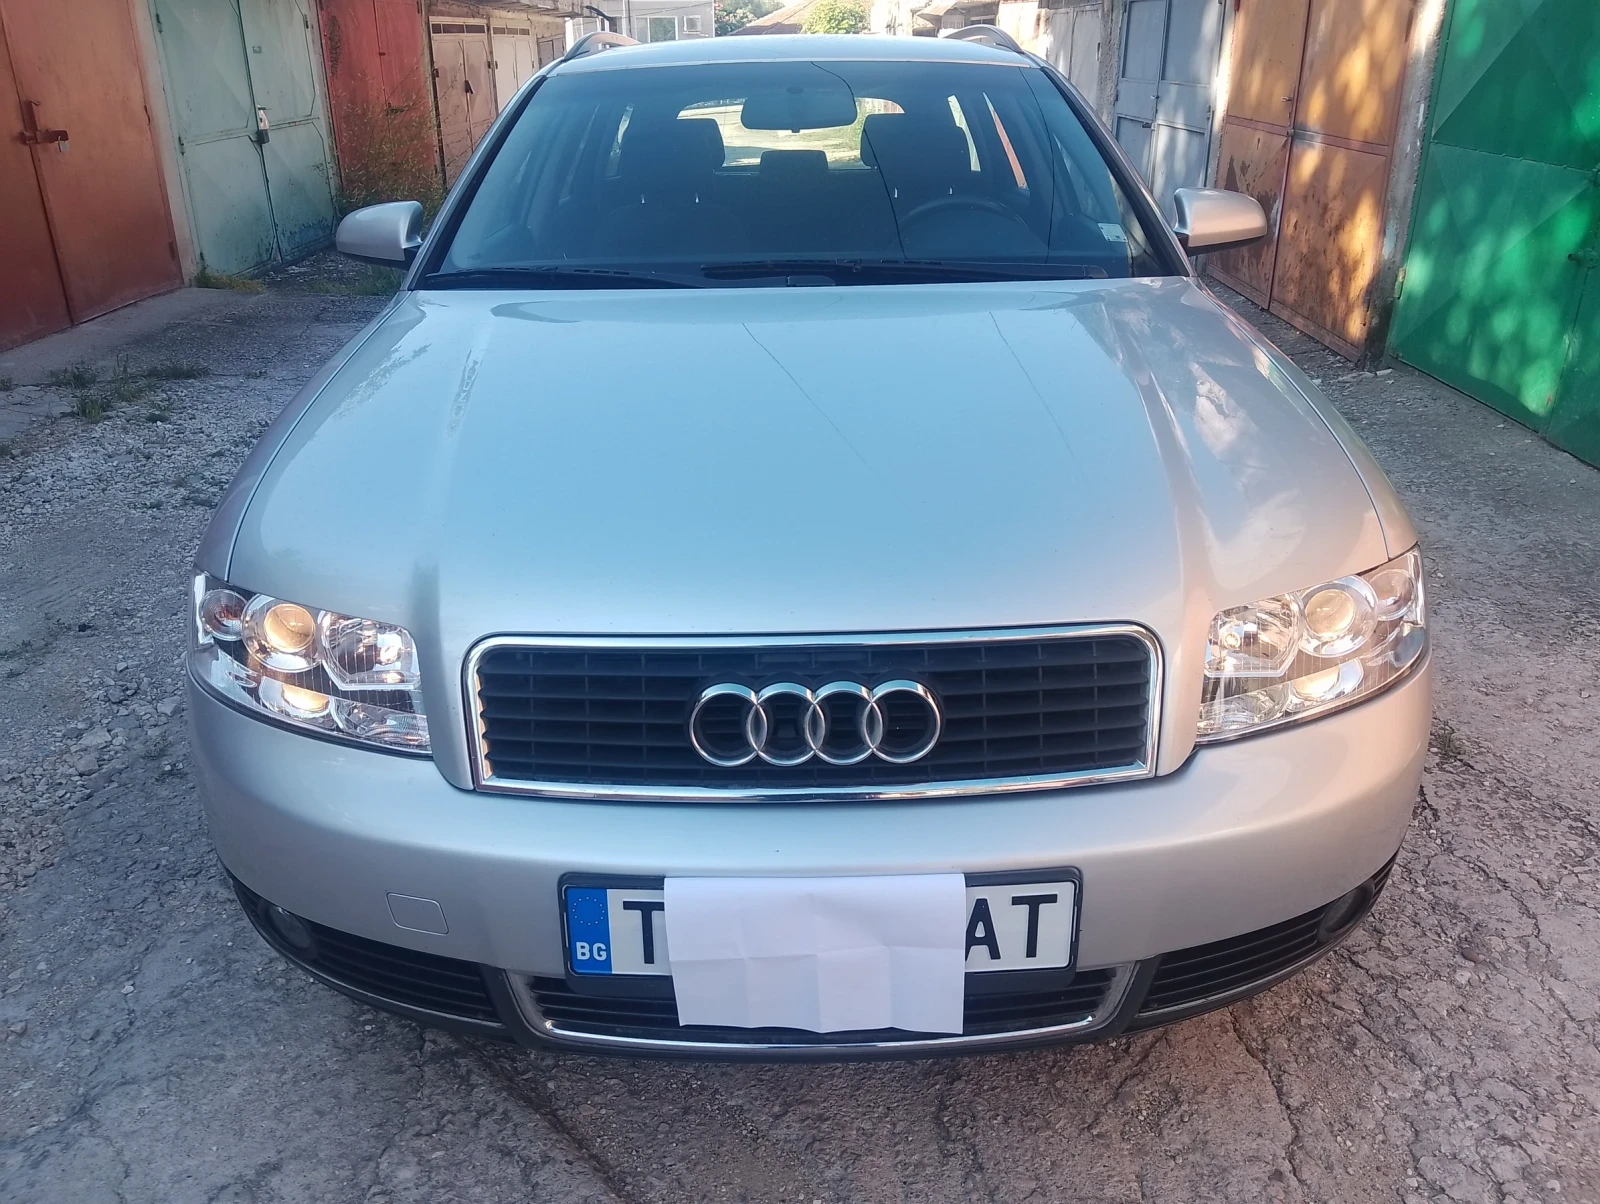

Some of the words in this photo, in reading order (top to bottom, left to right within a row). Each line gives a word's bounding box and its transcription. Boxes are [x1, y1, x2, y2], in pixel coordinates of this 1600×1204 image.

[576, 941, 607, 961] BG
[622, 901, 665, 965] T
[964, 893, 1058, 960] AT
